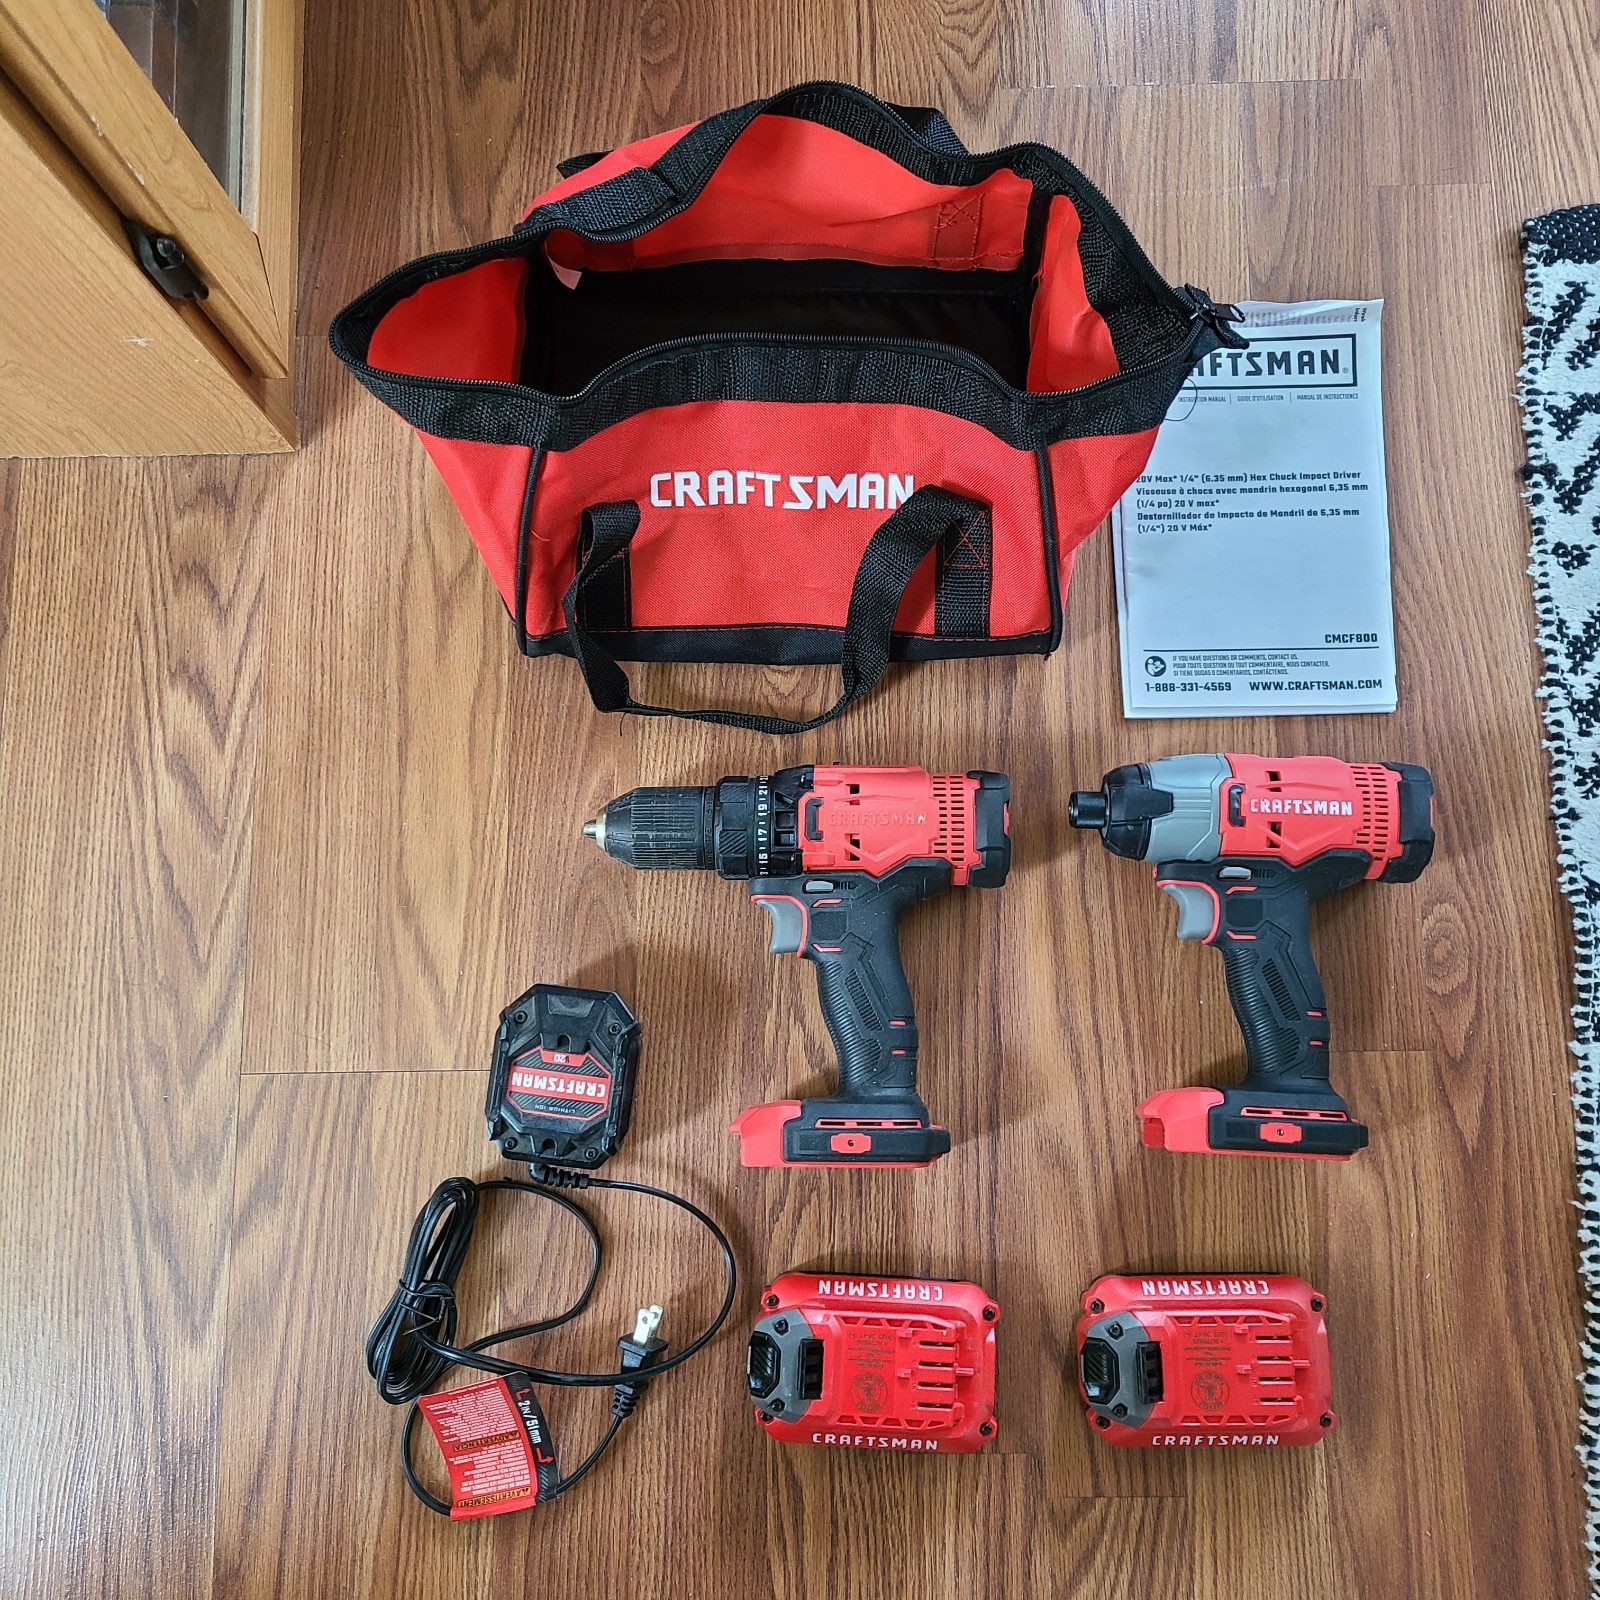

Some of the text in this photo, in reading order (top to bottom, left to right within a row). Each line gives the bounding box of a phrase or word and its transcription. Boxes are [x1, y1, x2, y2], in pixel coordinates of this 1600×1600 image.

[1136, 475, 1152, 483] 20V
[1180, 474, 1199, 483] 1/4"
[1202, 473, 1225, 484] (6.35
[1227, 473, 1248, 483] mm)
[1270, 473, 1297, 481] Chuck
[1300, 472, 1331, 481] Impact
[1333, 471, 1361, 479] Driver
[650, 469, 914, 510] CRAFTSMAN
[1240, 485, 1277, 494] mandrin
[1279, 484, 1326, 493] hexagonal
[1329, 483, 1349, 492] 6,35
[1137, 499, 1155, 509] (1/4
[1158, 499, 1172, 509] po)
[1174, 500, 1185, 508] 20
[1188, 500, 1194, 508] V
[1138, 512, 1201, 520] Destornillador
[1217, 511, 1254, 519] Impacto
[1270, 509, 1304, 517] Mandril
[1320, 508, 1340, 517] 6,35
[1138, 524, 1164, 534] (1/4")
[1168, 524, 1178, 532] 20
[1325, 633, 1378, 643] CMCF800
[1146, 682, 1231, 692] 1-888-331-4569
[1249, 679, 1382, 691] WWW.CRAFTSMAN.COM
[758, 786, 768, 795] 21
[758, 804, 768, 816] 19
[1250, 798, 1353, 816] CRAFTSMAN
[758, 828, 768, 841] 17
[759, 853, 768, 864] 15
[512, 1072, 606, 1098] CRAFTSMAN
[818, 1280, 943, 1301] CRAFTSMAN
[1142, 1280, 1270, 1296] CRAFTSMAN
[455, 1434, 510, 1451] ADVERTENCIA
[812, 1433, 938, 1450] CRAFTSMAN
[1152, 1435, 1279, 1446] CRAFTSMAN
[460, 1490, 521, 1507] AVERTISSEMENT
